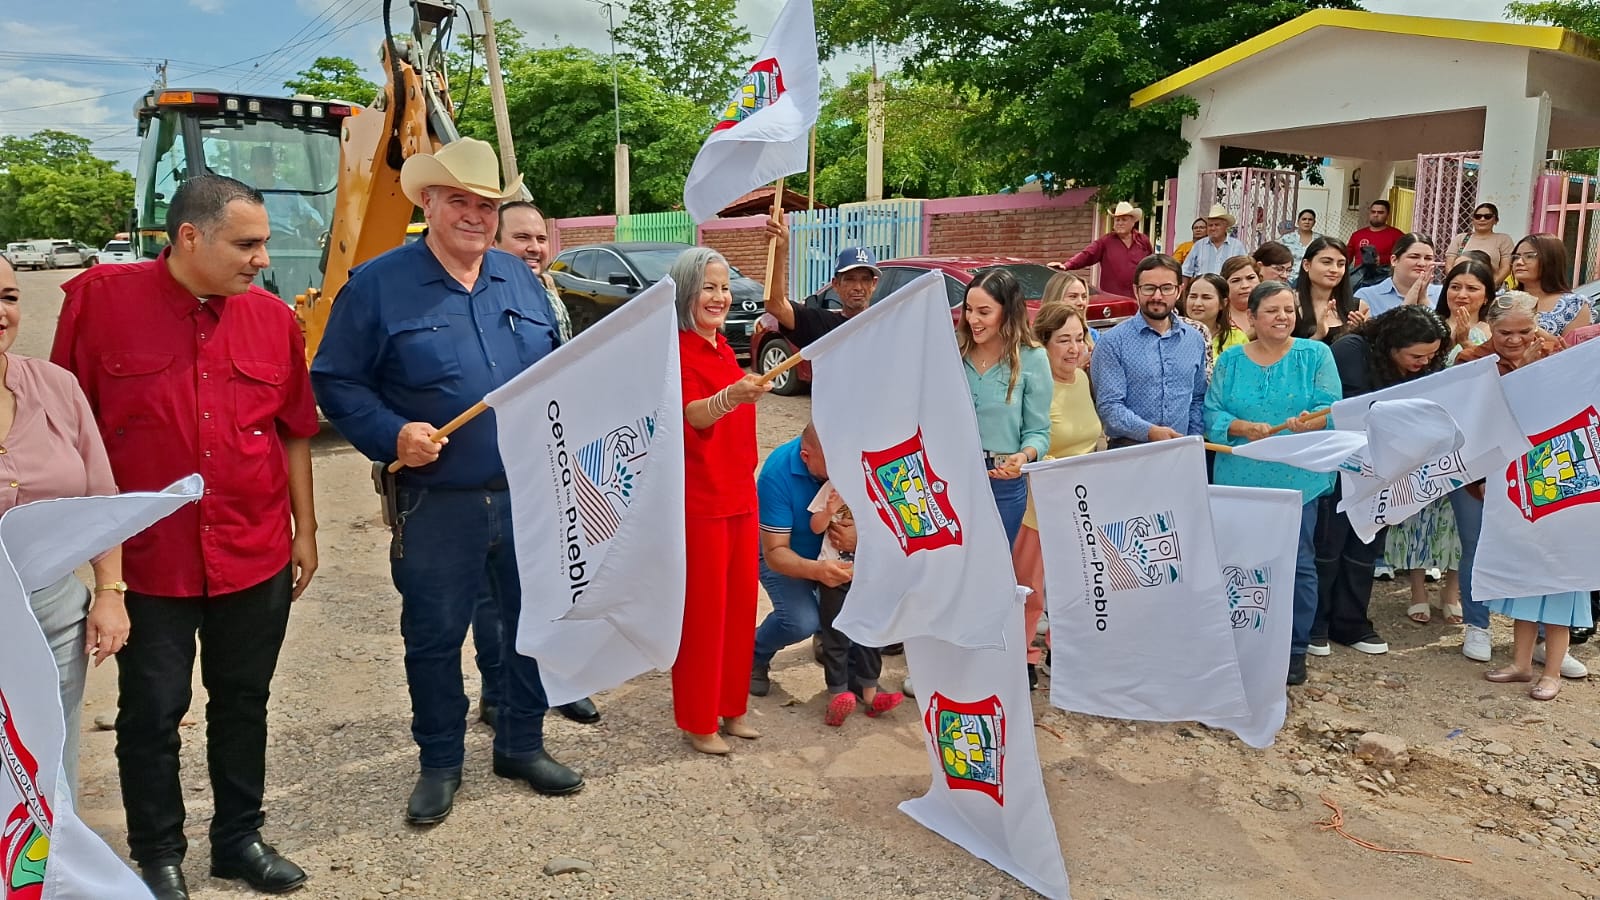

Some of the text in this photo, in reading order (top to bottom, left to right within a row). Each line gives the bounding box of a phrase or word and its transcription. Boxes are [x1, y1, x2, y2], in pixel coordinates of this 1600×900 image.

[856, 247, 869, 263] LA
[547, 400, 571, 488] Cerca
[1075, 485, 1096, 545] Cerca
[1091, 562, 1108, 631] Pueblo
